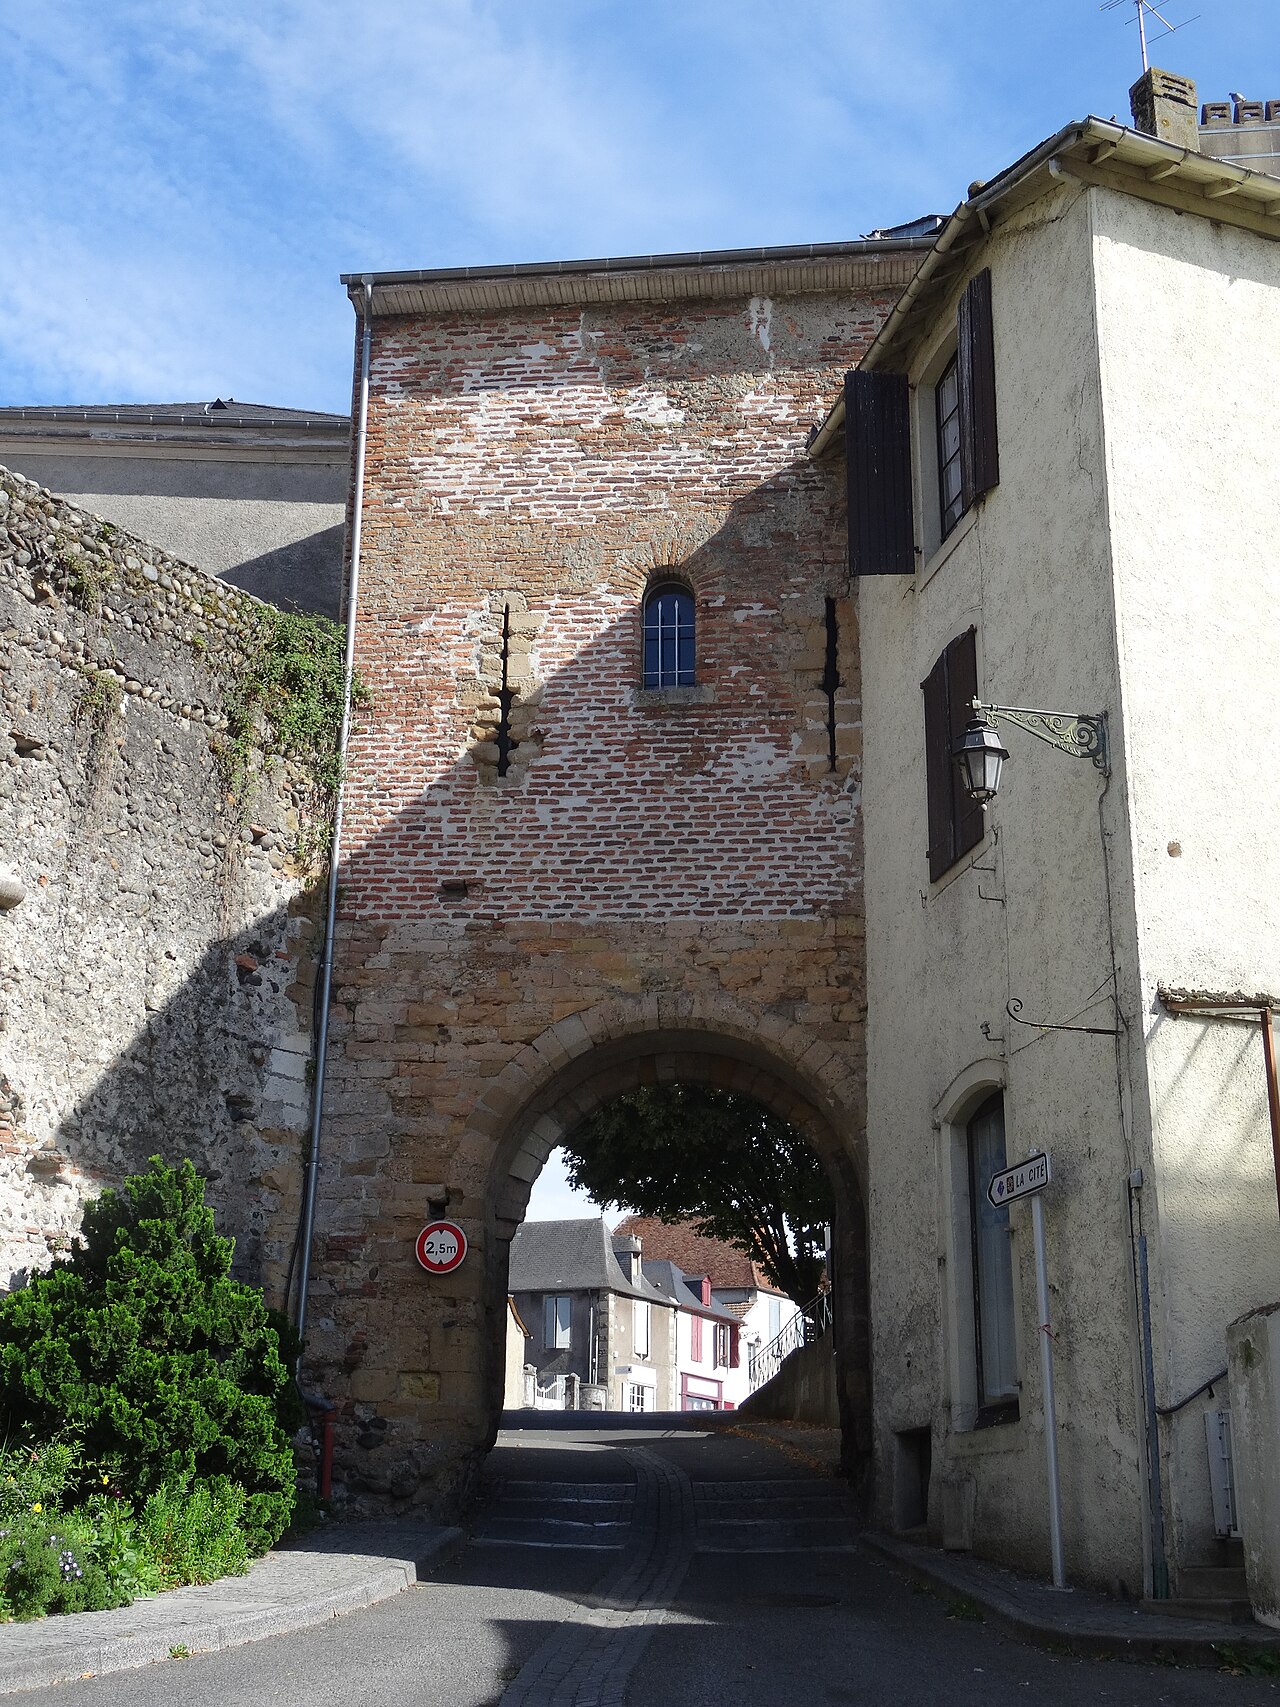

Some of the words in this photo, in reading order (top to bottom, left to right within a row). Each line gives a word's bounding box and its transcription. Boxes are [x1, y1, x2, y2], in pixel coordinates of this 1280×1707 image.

[1016, 1173, 1025, 1188] LA
[1028, 1160, 1045, 1182] CITÉ
[425, 1241, 456, 1256] 2,5m
